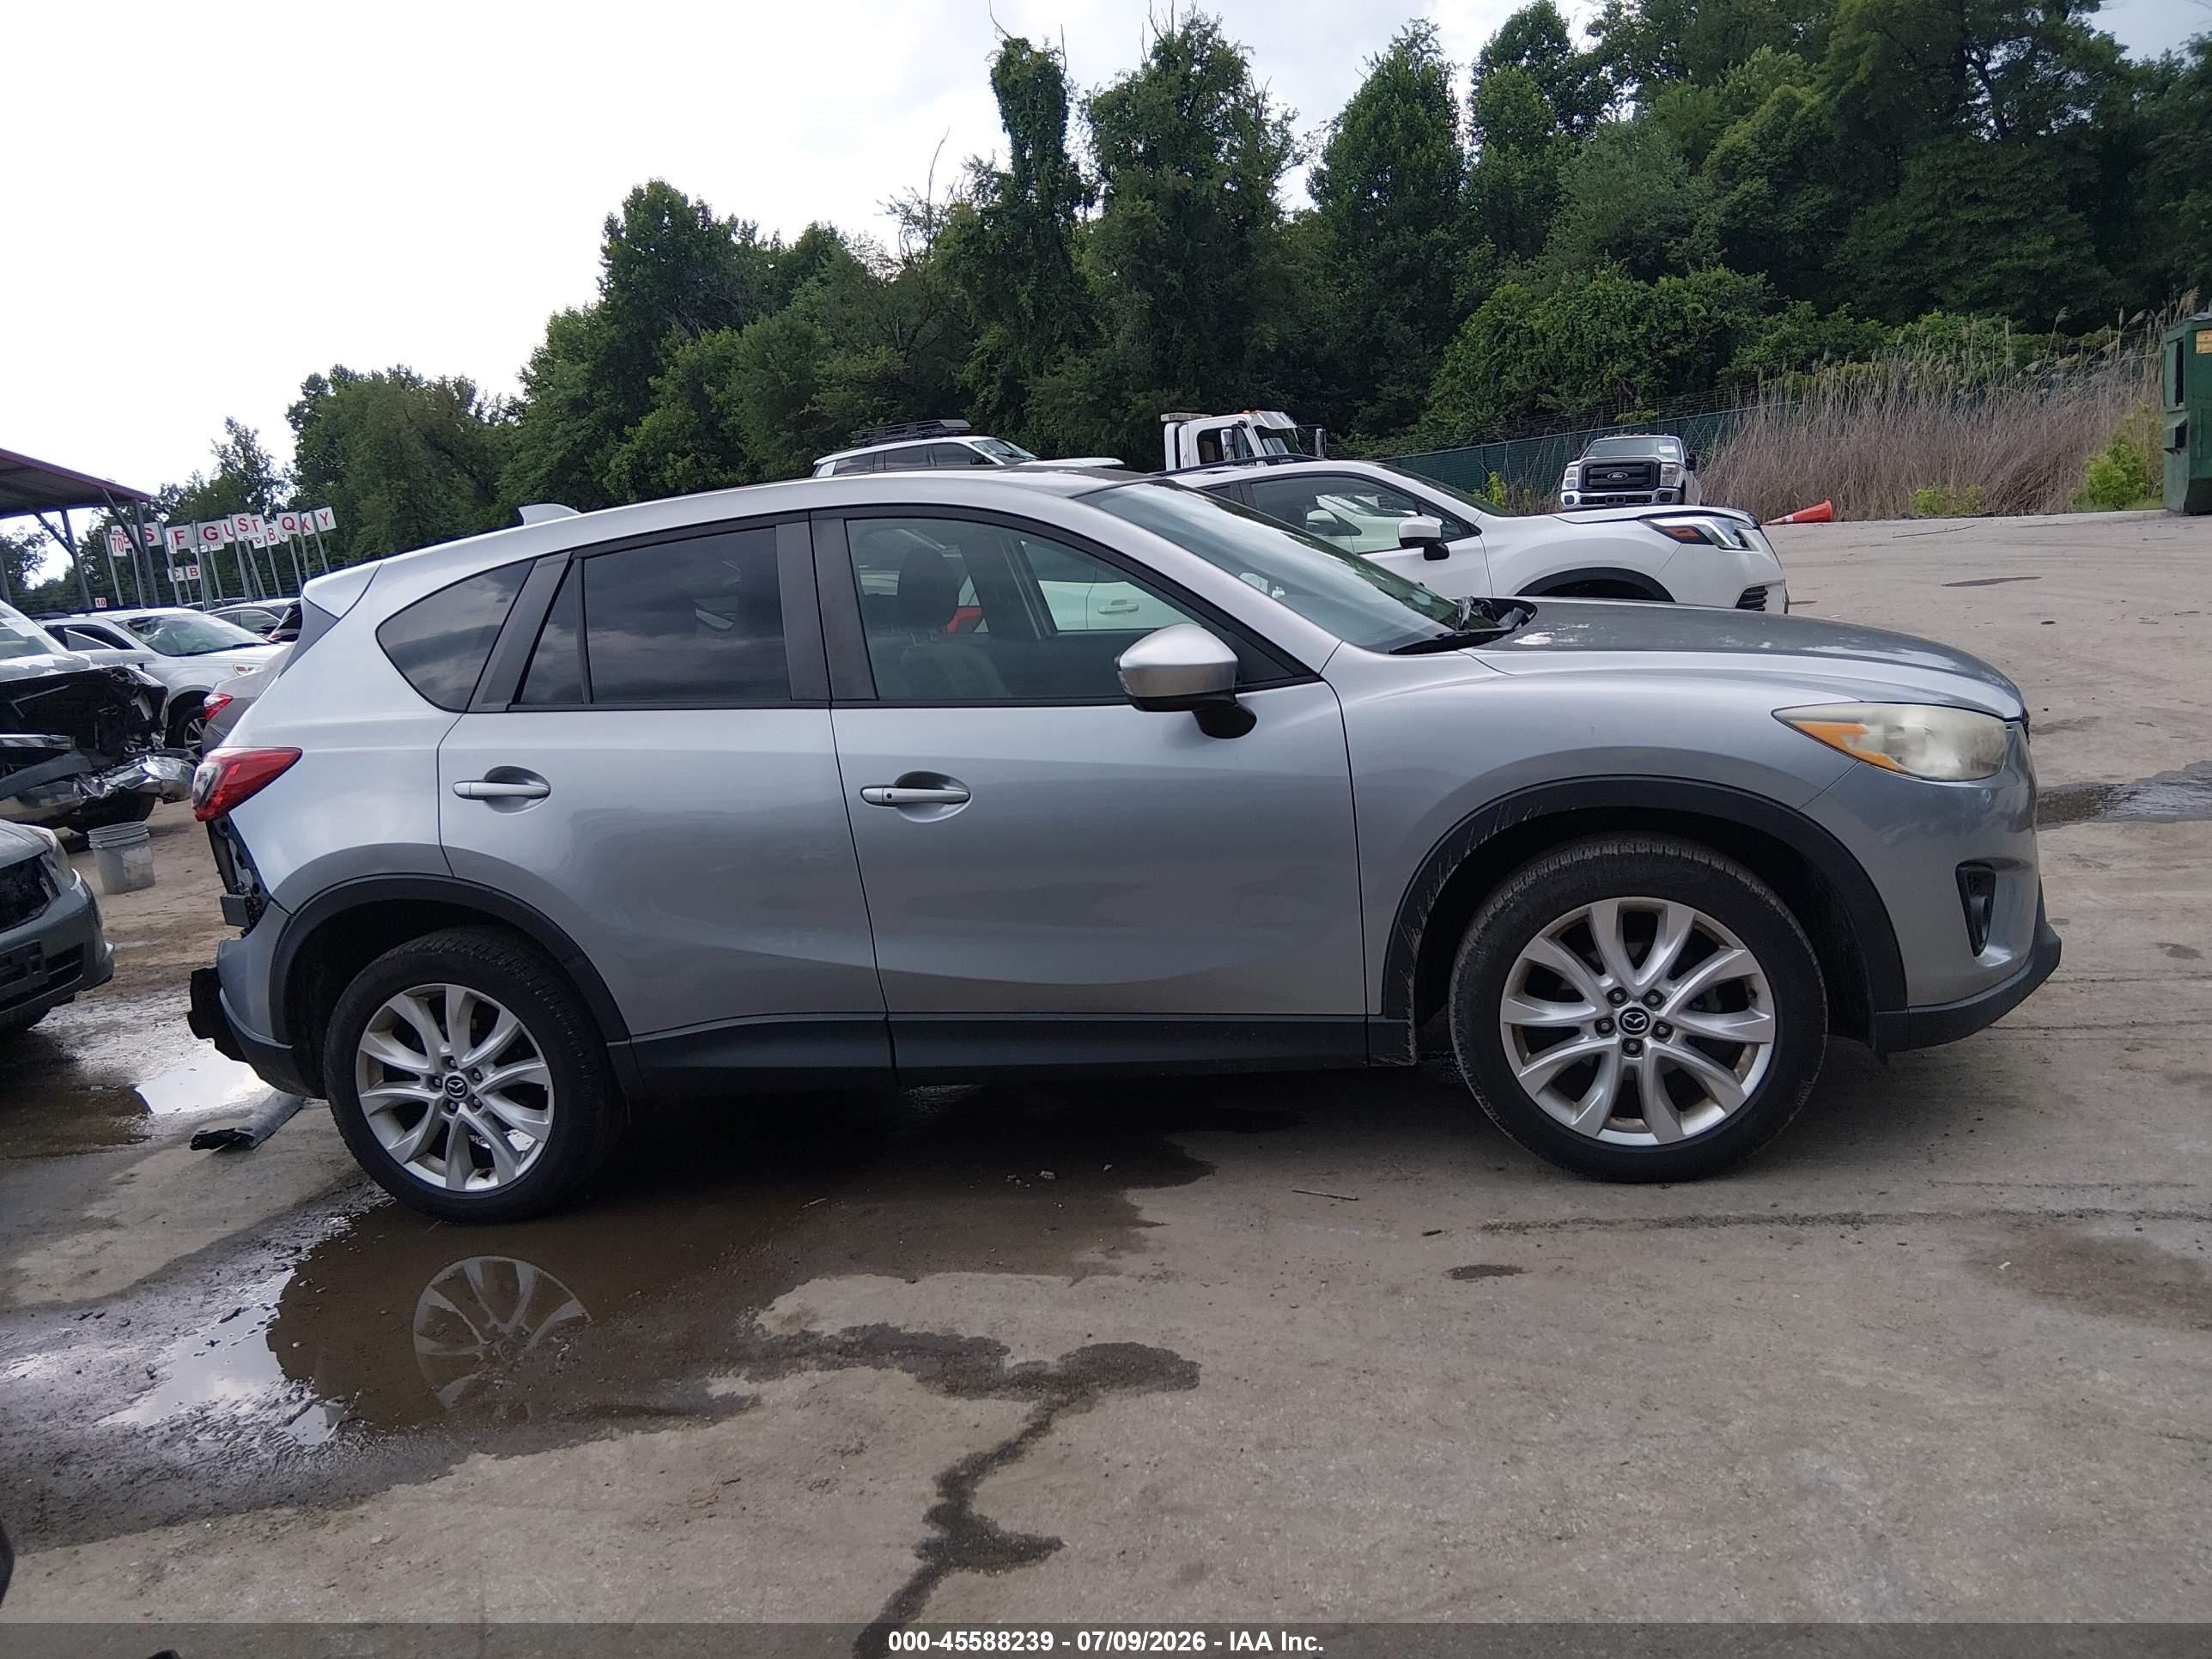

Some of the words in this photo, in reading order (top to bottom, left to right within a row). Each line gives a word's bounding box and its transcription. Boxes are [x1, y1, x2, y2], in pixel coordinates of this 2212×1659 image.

[238, 517, 249, 532] S
[282, 516, 296, 531] Q
[319, 512, 328, 526] Y
[173, 530, 185, 545] F
[203, 526, 219, 541] G
[267, 527, 276, 541] B
[112, 538, 125, 552] 70
[189, 567, 198, 577] B
